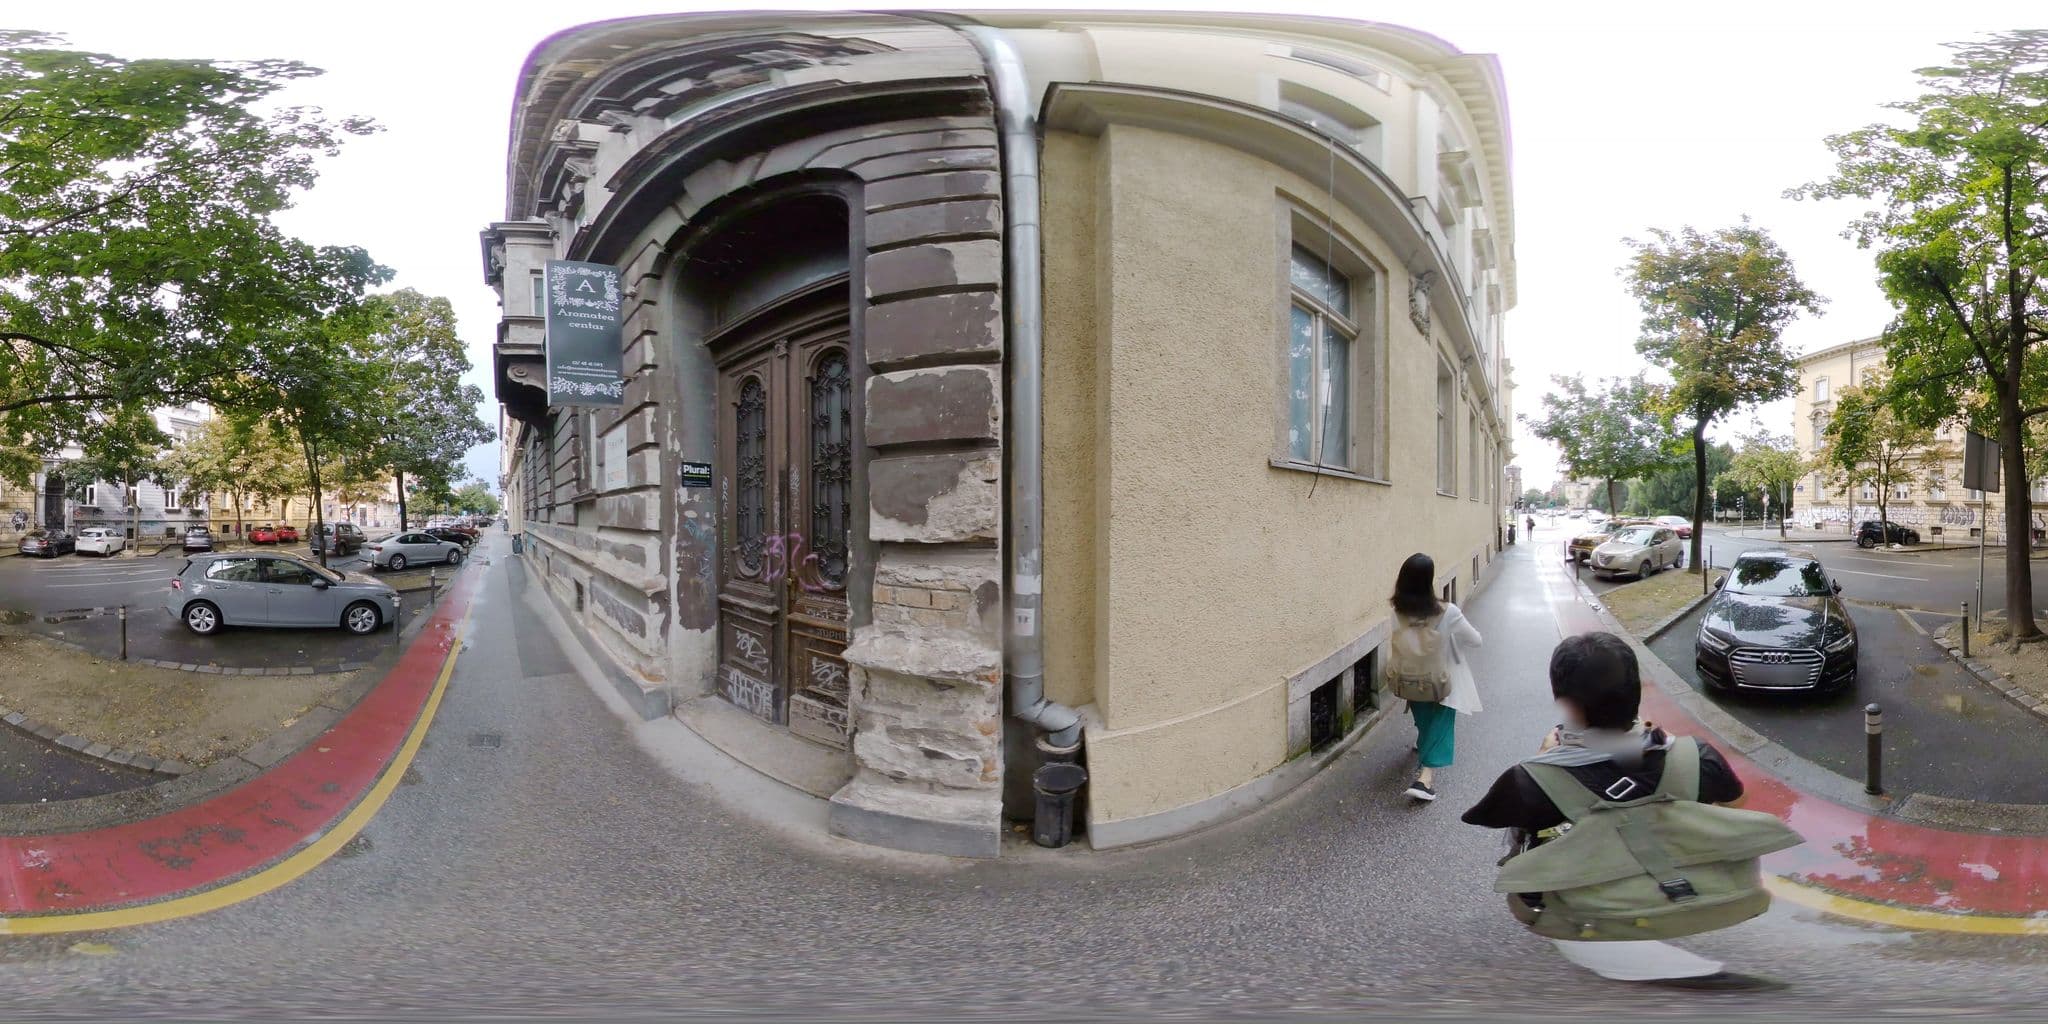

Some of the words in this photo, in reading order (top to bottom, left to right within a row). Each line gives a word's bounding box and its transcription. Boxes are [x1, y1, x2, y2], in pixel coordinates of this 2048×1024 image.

[576, 279, 596, 293] A
[557, 308, 615, 321] Aromatea
[568, 322, 605, 331] centar
[683, 464, 710, 475] Plural:
